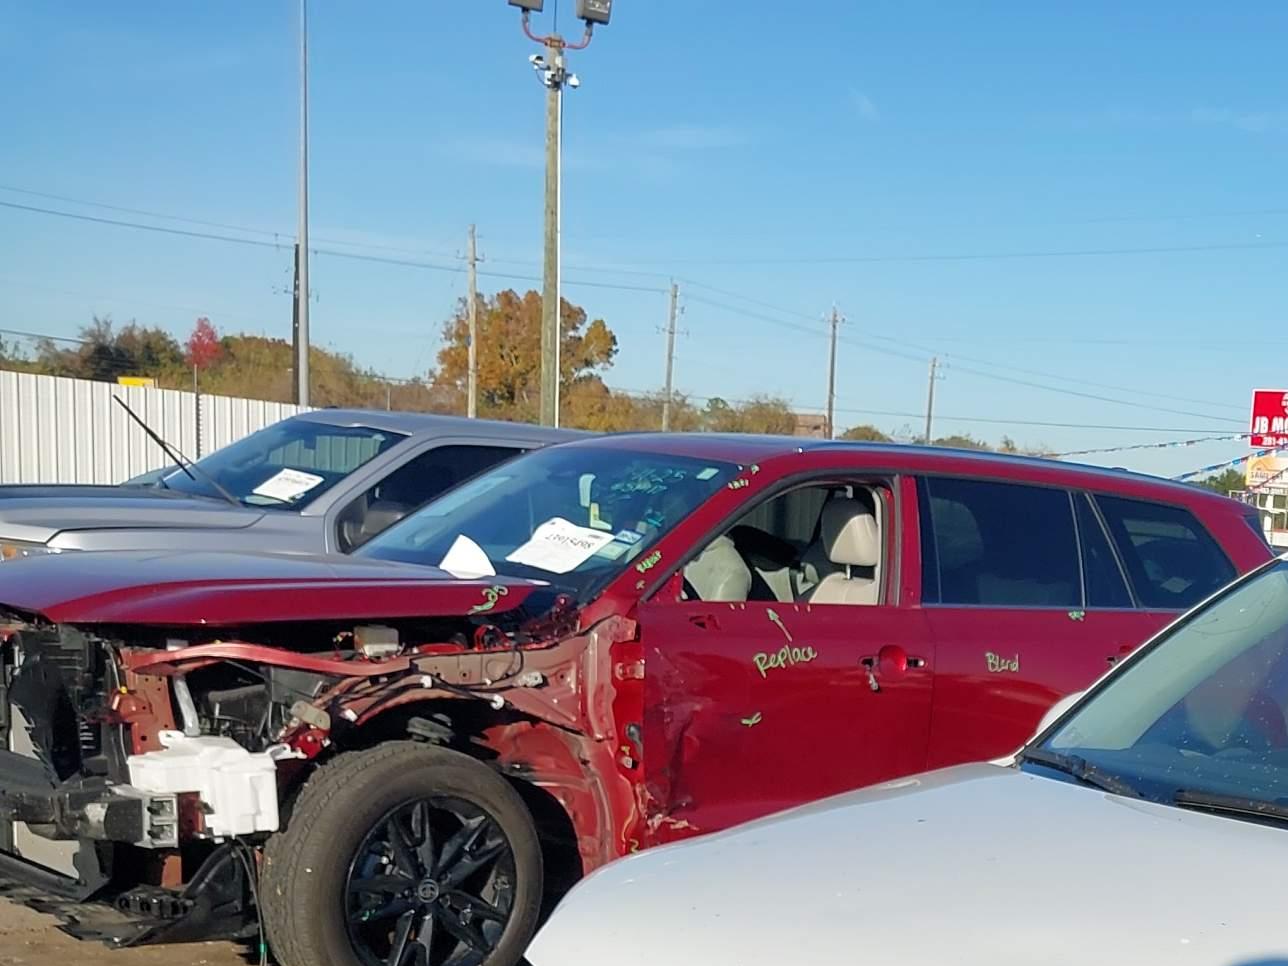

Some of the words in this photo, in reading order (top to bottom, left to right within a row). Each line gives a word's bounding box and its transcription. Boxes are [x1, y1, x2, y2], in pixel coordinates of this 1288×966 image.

[1253, 416, 1269, 434] JB
[753, 645, 818, 678] Replace
[985, 652, 1019, 672] Blend
